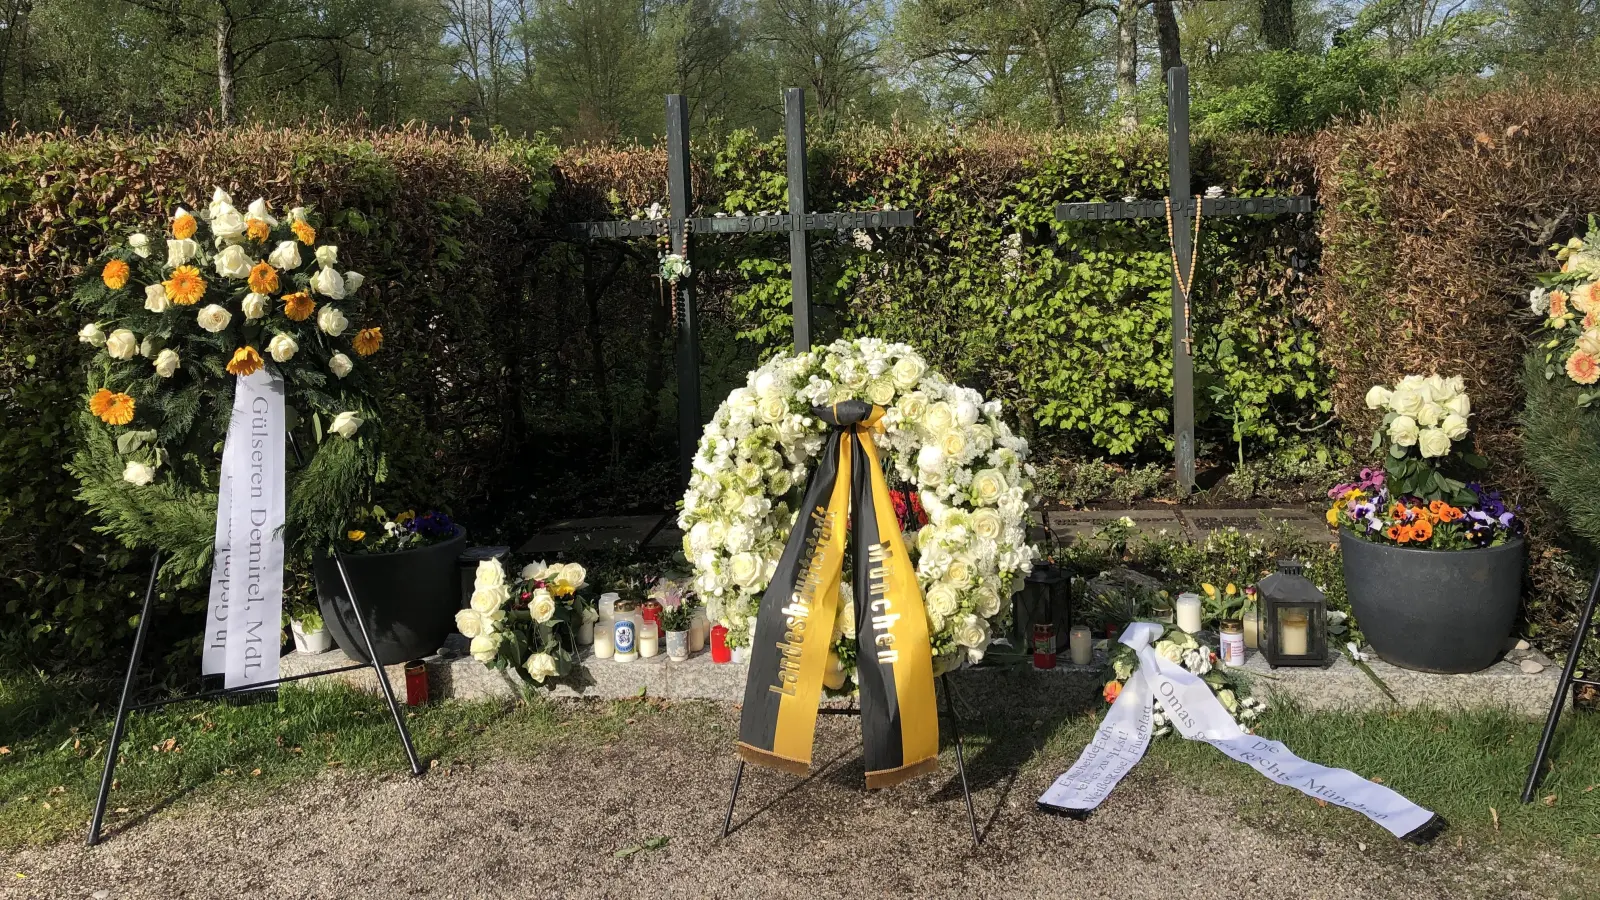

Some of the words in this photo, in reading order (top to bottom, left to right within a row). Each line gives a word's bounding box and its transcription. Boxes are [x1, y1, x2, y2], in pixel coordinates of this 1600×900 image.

[737, 213, 815, 232] SOPHIE
[1066, 200, 1196, 220] CHRISTOPH
[1214, 196, 1304, 215] PROBST
[251, 397, 269, 500] Gülseren
[244, 509, 267, 611] Demirel,
[769, 505, 837, 697] Landeshauptstadt
[868, 539, 901, 665] München
[211, 630, 227, 649] In
[243, 621, 263, 679] MdL
[1128, 705, 1152, 756] Flugblatt
[1160, 681, 1195, 729] Omas
[1302, 778, 1389, 820] München
[1251, 741, 1279, 754] Die
